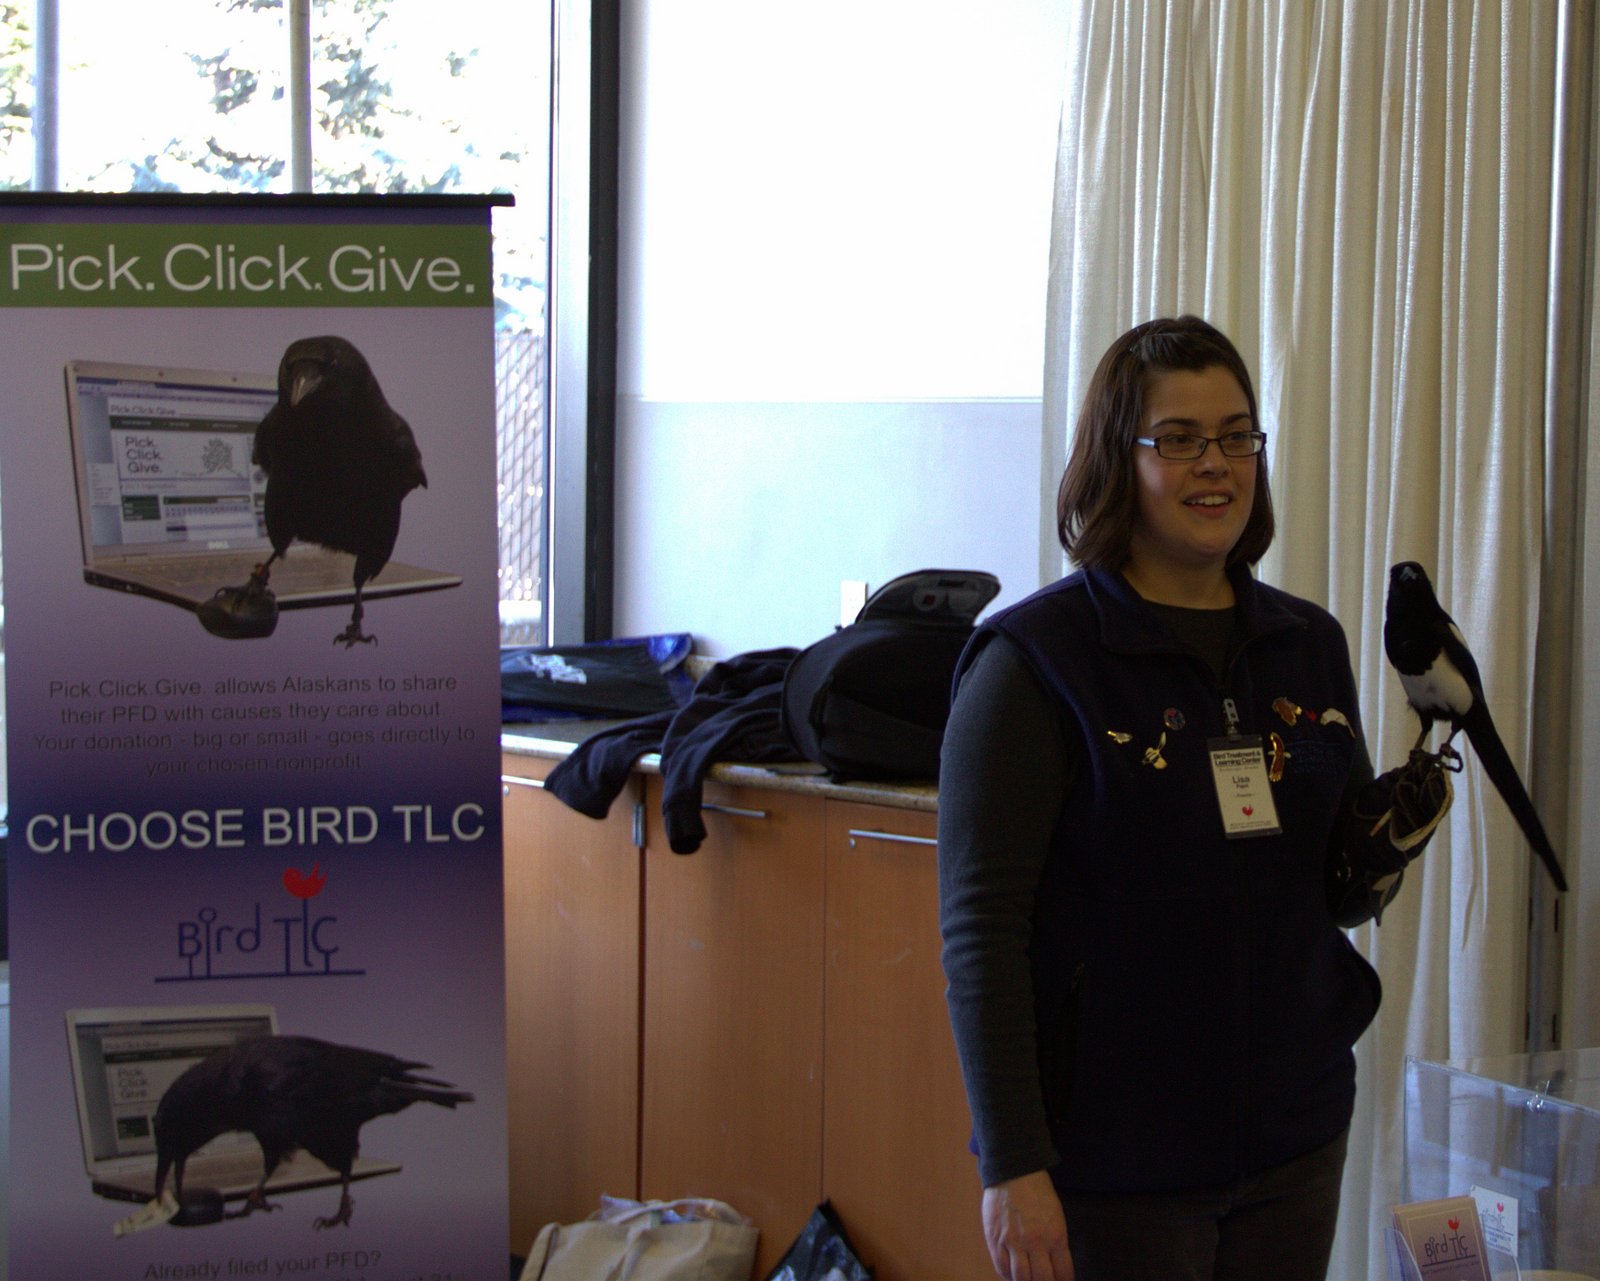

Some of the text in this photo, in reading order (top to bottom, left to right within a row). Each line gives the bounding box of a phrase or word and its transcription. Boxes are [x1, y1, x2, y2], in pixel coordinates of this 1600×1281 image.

[10, 243, 475, 293] Pick.Click.Give.
[214, 677, 276, 695] allows
[282, 675, 372, 693] Alaskans
[378, 675, 396, 692] to
[402, 674, 457, 691] share
[60, 707, 106, 724] their
[112, 705, 157, 722] PFD
[164, 705, 205, 721] with
[211, 705, 282, 721] causes
[289, 702, 330, 722] they
[337, 703, 379, 718] care
[33, 734, 77, 751] Your
[84, 733, 172, 750] donation
[193, 730, 222, 749] big
[229, 732, 249, 746] or
[257, 728, 307, 745] small
[328, 730, 375, 746] goes
[381, 726, 450, 744] directly
[457, 726, 475, 741] to
[146, 760, 189, 777] your
[196, 757, 268, 773] chosen
[26, 803, 485, 853] CHOOSE BIRD TLC
[178, 902, 261, 976] Bird
[1424, 1233, 1448, 1263] Bird
[144, 1250, 382, 1280] Already filed your PFD?
